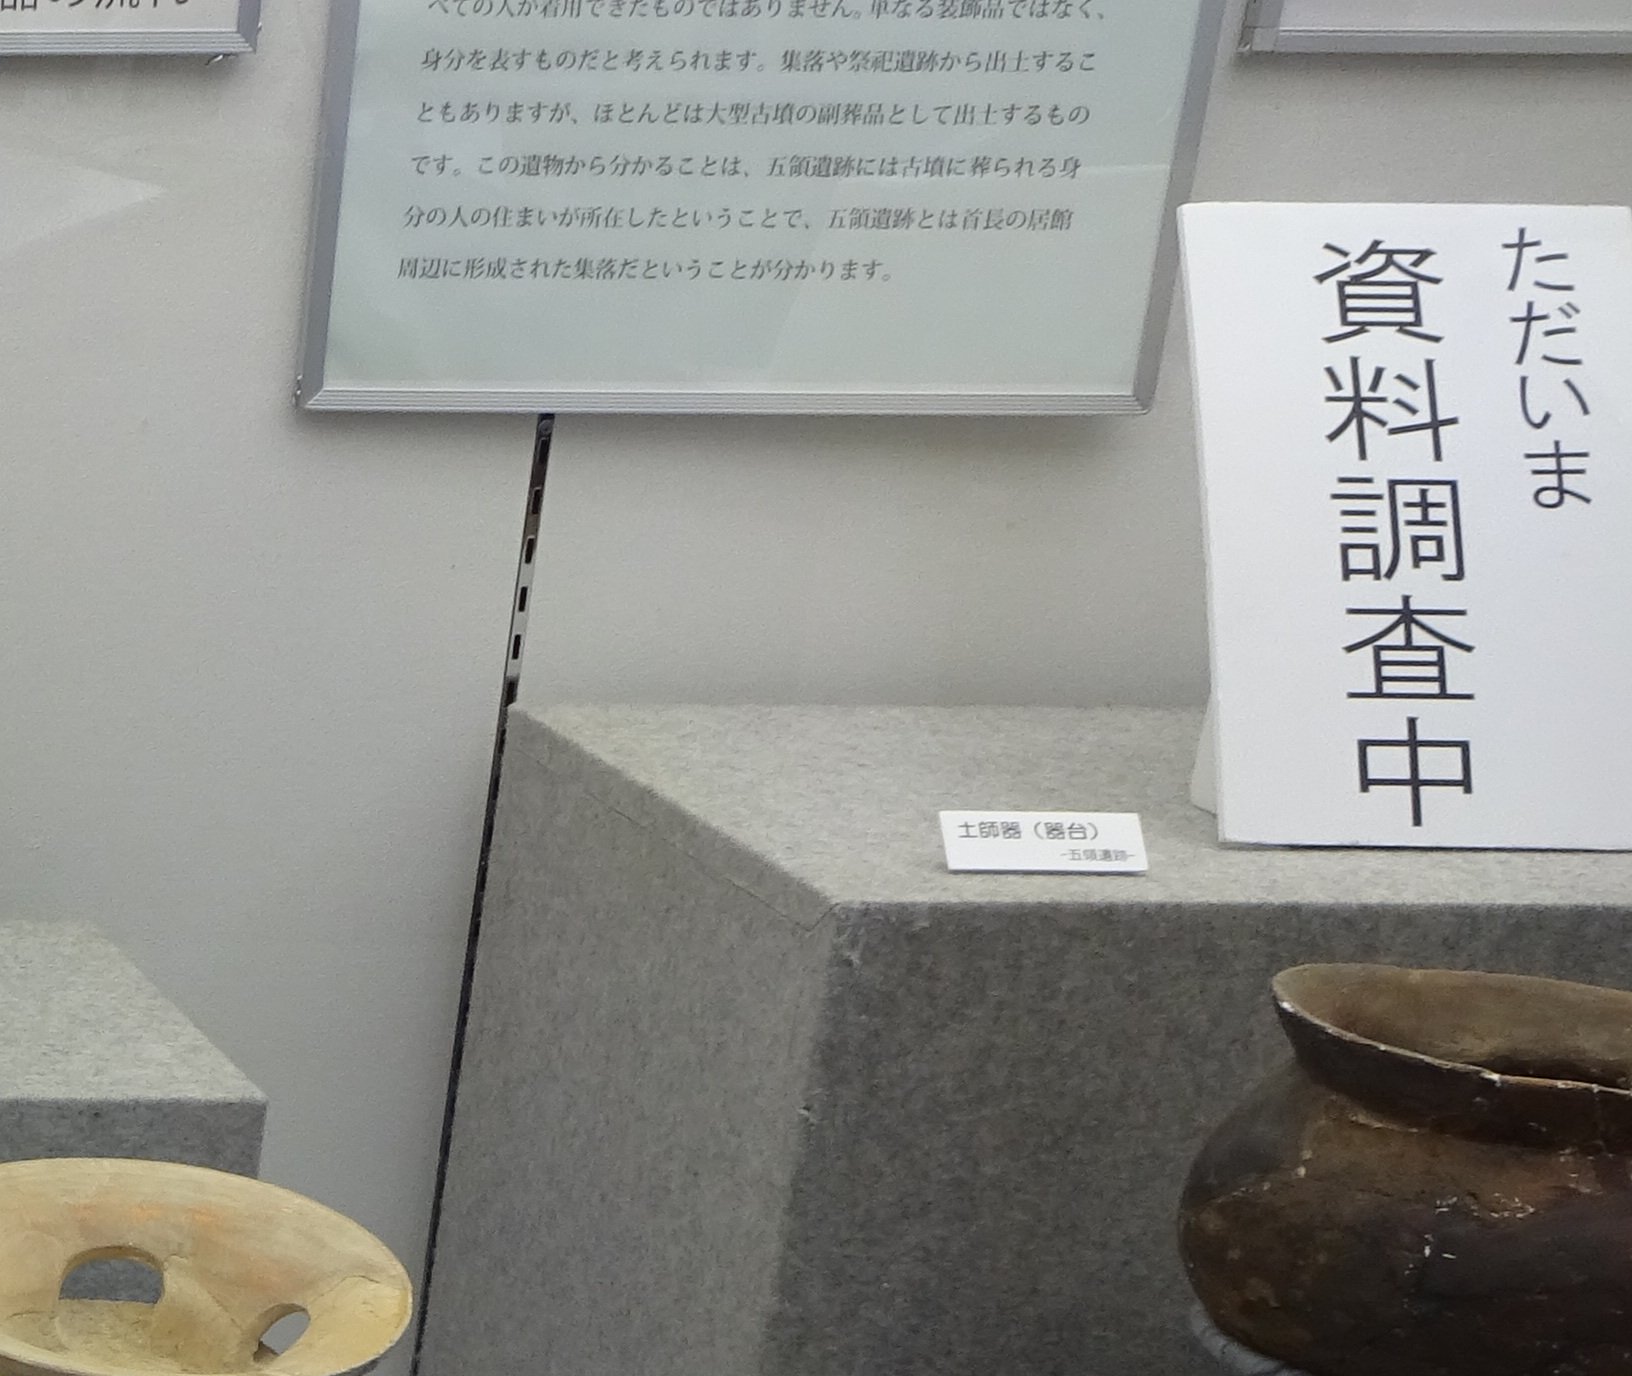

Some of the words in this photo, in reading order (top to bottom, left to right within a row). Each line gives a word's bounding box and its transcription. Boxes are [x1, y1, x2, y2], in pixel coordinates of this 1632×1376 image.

[421, 47, 1096, 73] 身分を表すものだと考えられます。集落や祭祀遺跡から出土するこ
[417, 101, 1090, 126] ともありますが、ほとんどは大型古墳の副葬品として出土するもの
[412, 153, 1081, 180] です。この遺物から分かることは、五領遺跡には古墳に葬られる身
[403, 205, 1074, 231] 分の人の住まいが所在したということで、五領遺跡とは首長の居館
[397, 257, 892, 282] 周辺に形成された集落だということが分かります。
[1501, 227, 1592, 510] ただいま
[1312, 239, 1476, 828] 資料調査中
